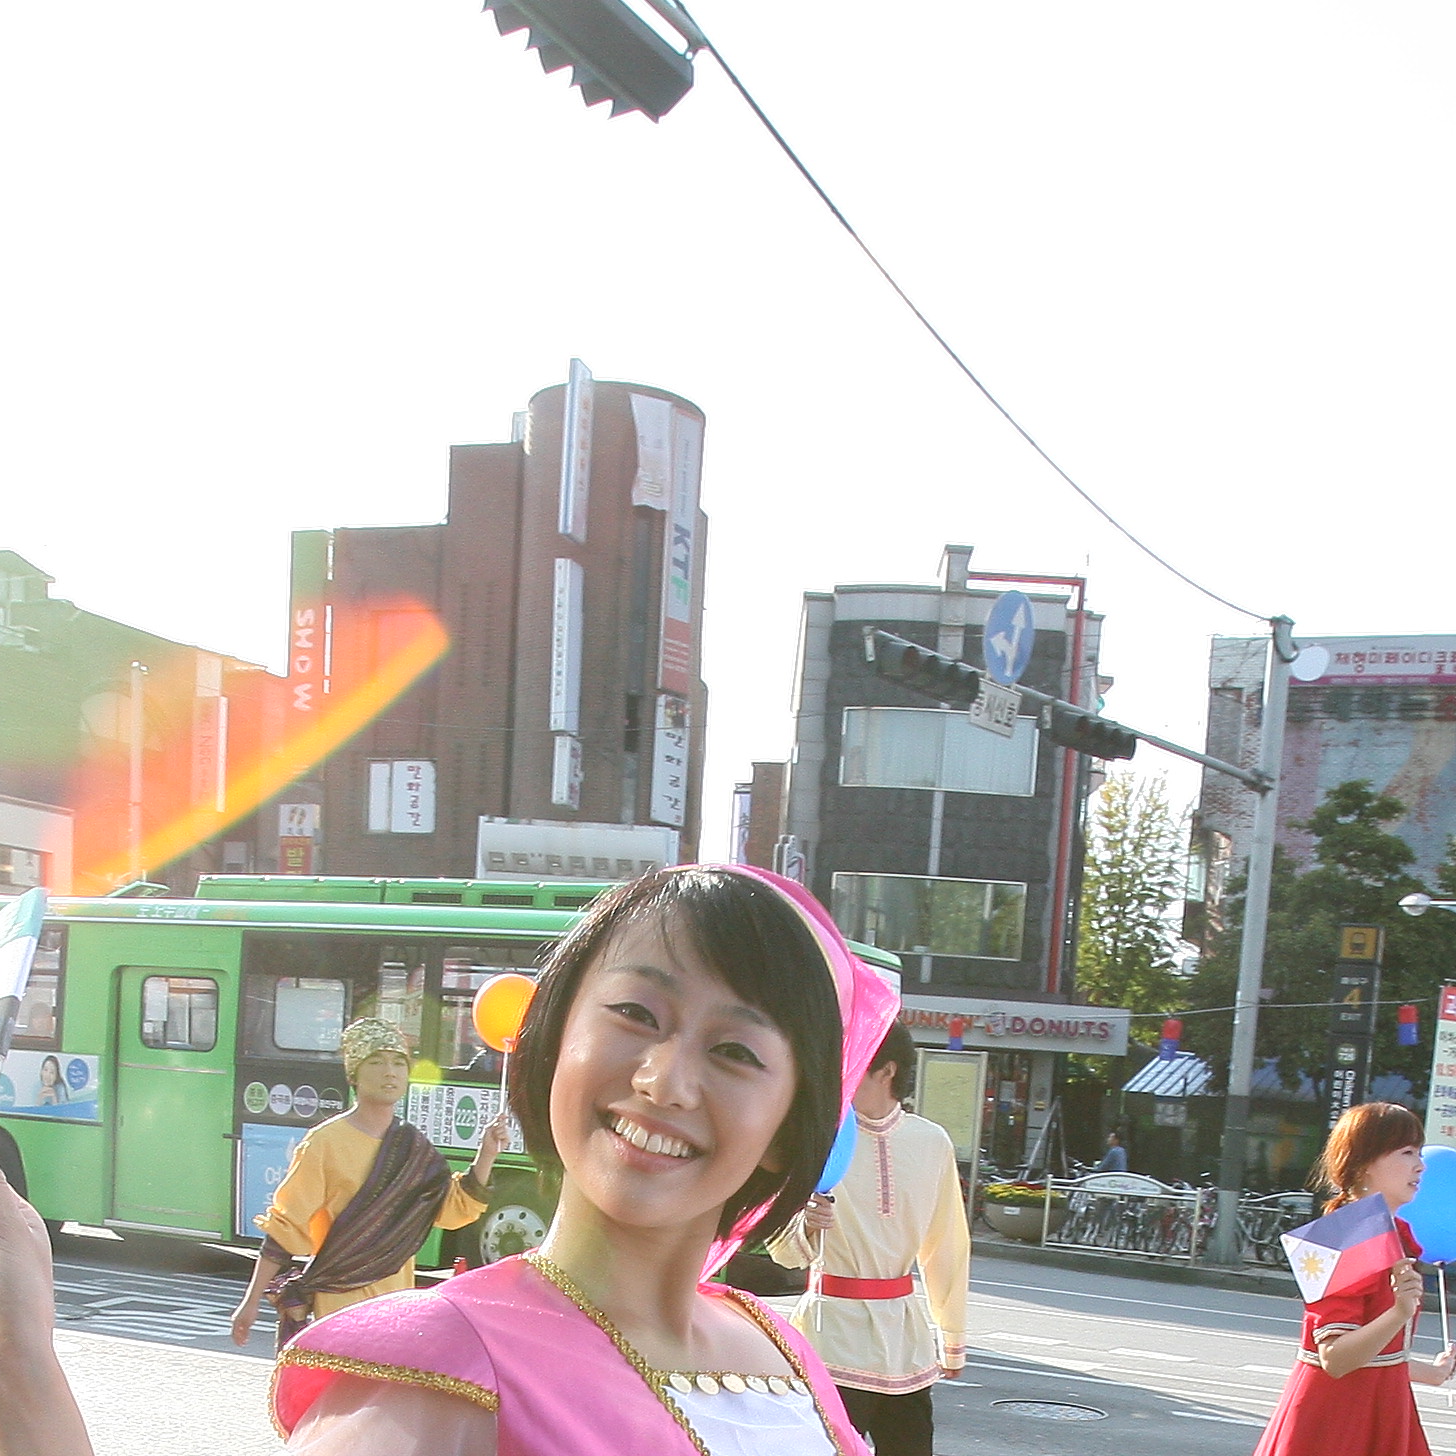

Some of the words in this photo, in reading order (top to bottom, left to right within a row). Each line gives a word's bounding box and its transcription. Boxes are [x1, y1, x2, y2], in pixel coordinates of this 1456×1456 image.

[671, 523, 691, 605] KTF
[294, 608, 316, 712] SHOW
[1344, 988, 1361, 1009] 4
[1011, 1016, 1110, 1040] DONUTS
